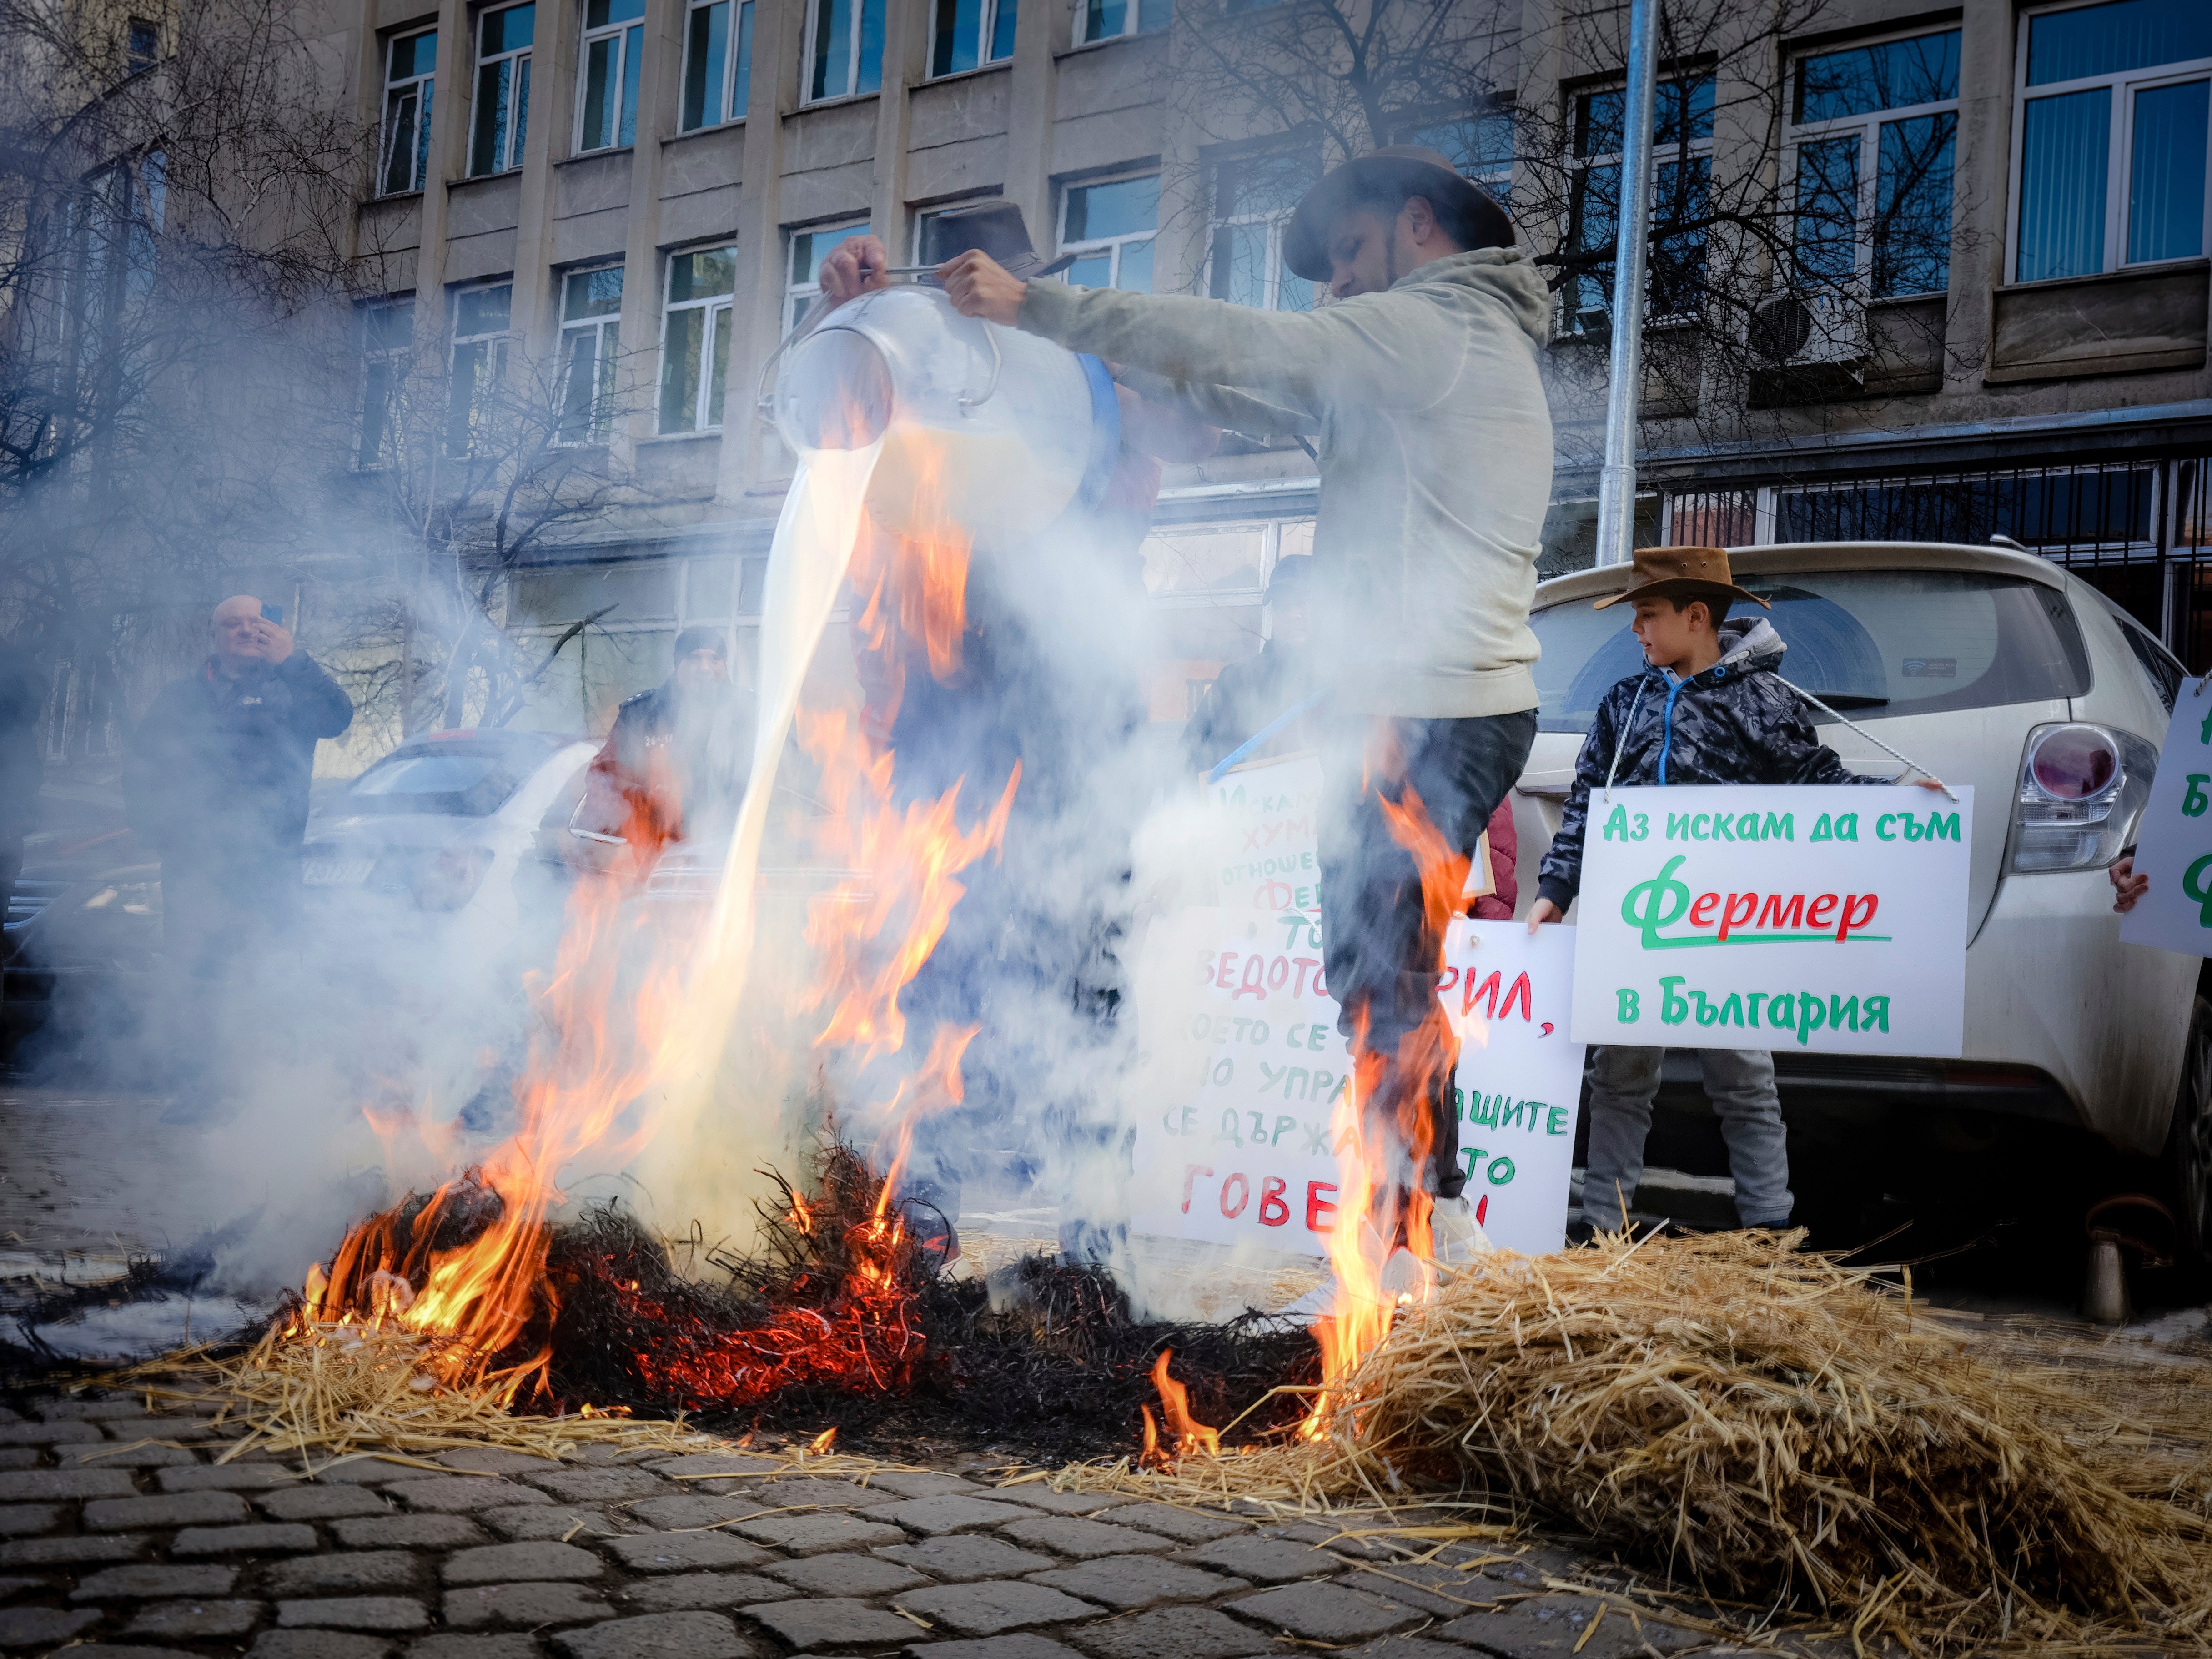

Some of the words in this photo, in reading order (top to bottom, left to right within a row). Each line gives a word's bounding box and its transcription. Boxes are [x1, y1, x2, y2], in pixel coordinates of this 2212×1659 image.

[1242, 814, 1318, 853] ХУМ
[1603, 804, 1649, 843] Аз
[1666, 811, 1795, 843] искам
[1809, 812, 1858, 843] да
[1876, 811, 1961, 843] съм
[1222, 850, 1319, 886] ОТНОШЕ
[1621, 855, 1892, 950] Фермер
[1616, 988, 1640, 1025] в
[1659, 975, 1891, 1046] България
[1287, 1022, 1330, 1051] СЕ
